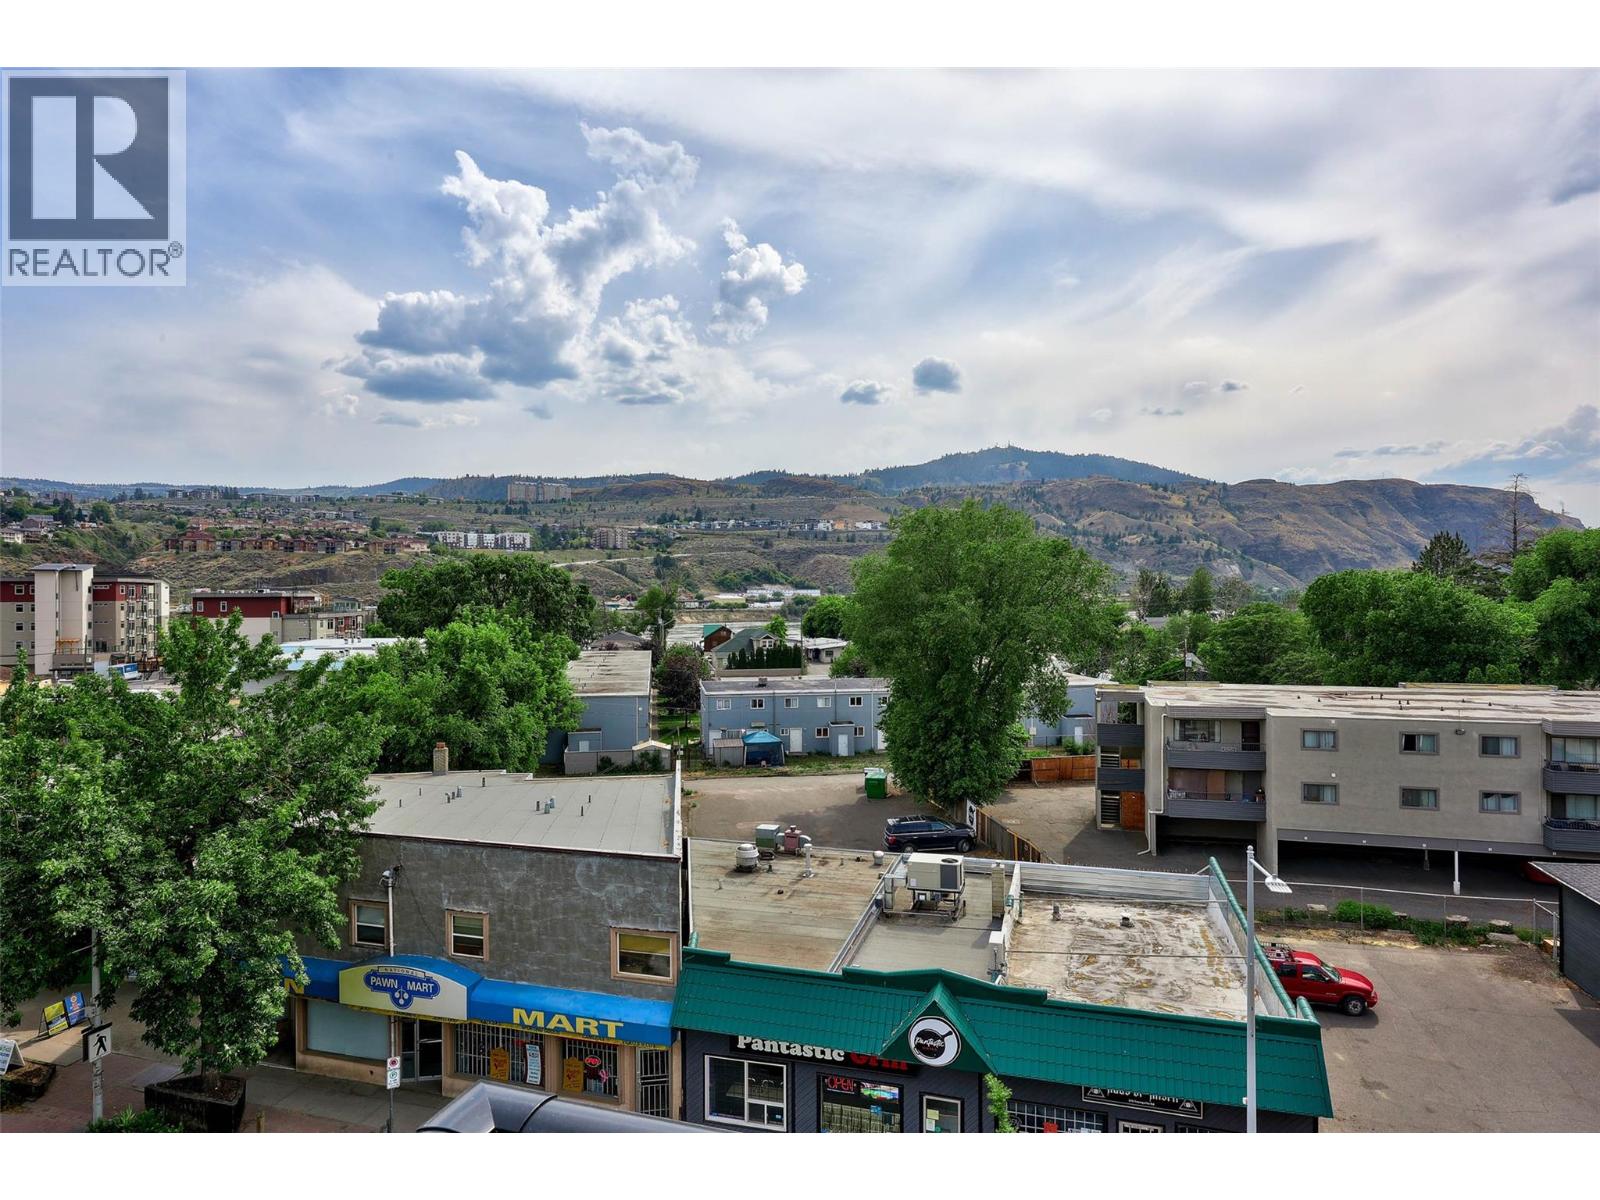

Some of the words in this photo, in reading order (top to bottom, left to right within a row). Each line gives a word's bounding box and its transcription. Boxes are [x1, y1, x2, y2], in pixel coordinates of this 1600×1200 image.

[370, 976, 398, 989] PAWN
[406, 981, 434, 993] MART
[512, 1007, 624, 1039] MART
[737, 1035, 845, 1062] Pantastic
[826, 1074, 854, 1093] OPEN
